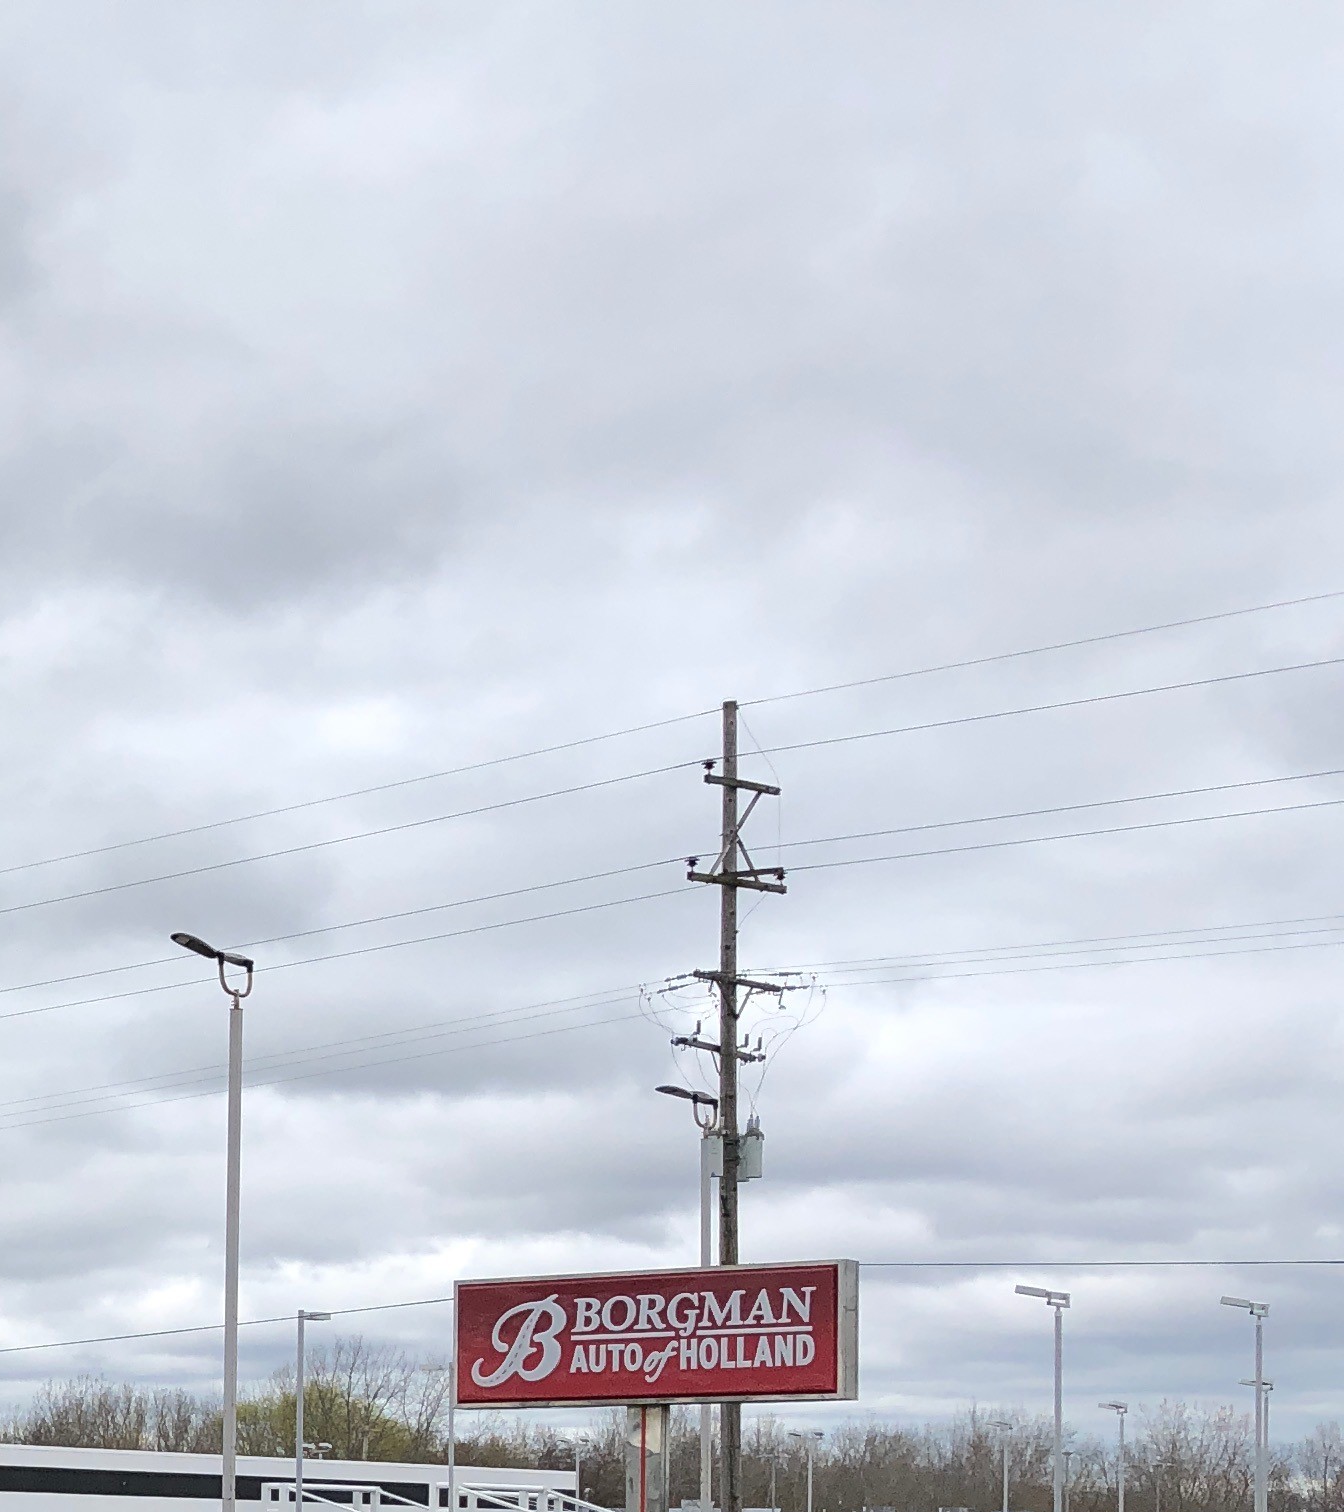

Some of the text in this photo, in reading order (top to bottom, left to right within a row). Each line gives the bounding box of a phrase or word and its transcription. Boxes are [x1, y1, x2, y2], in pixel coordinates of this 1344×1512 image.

[571, 1286, 816, 1337] BORGMAN
[570, 1334, 814, 1383] AUTO of HOLLAND
